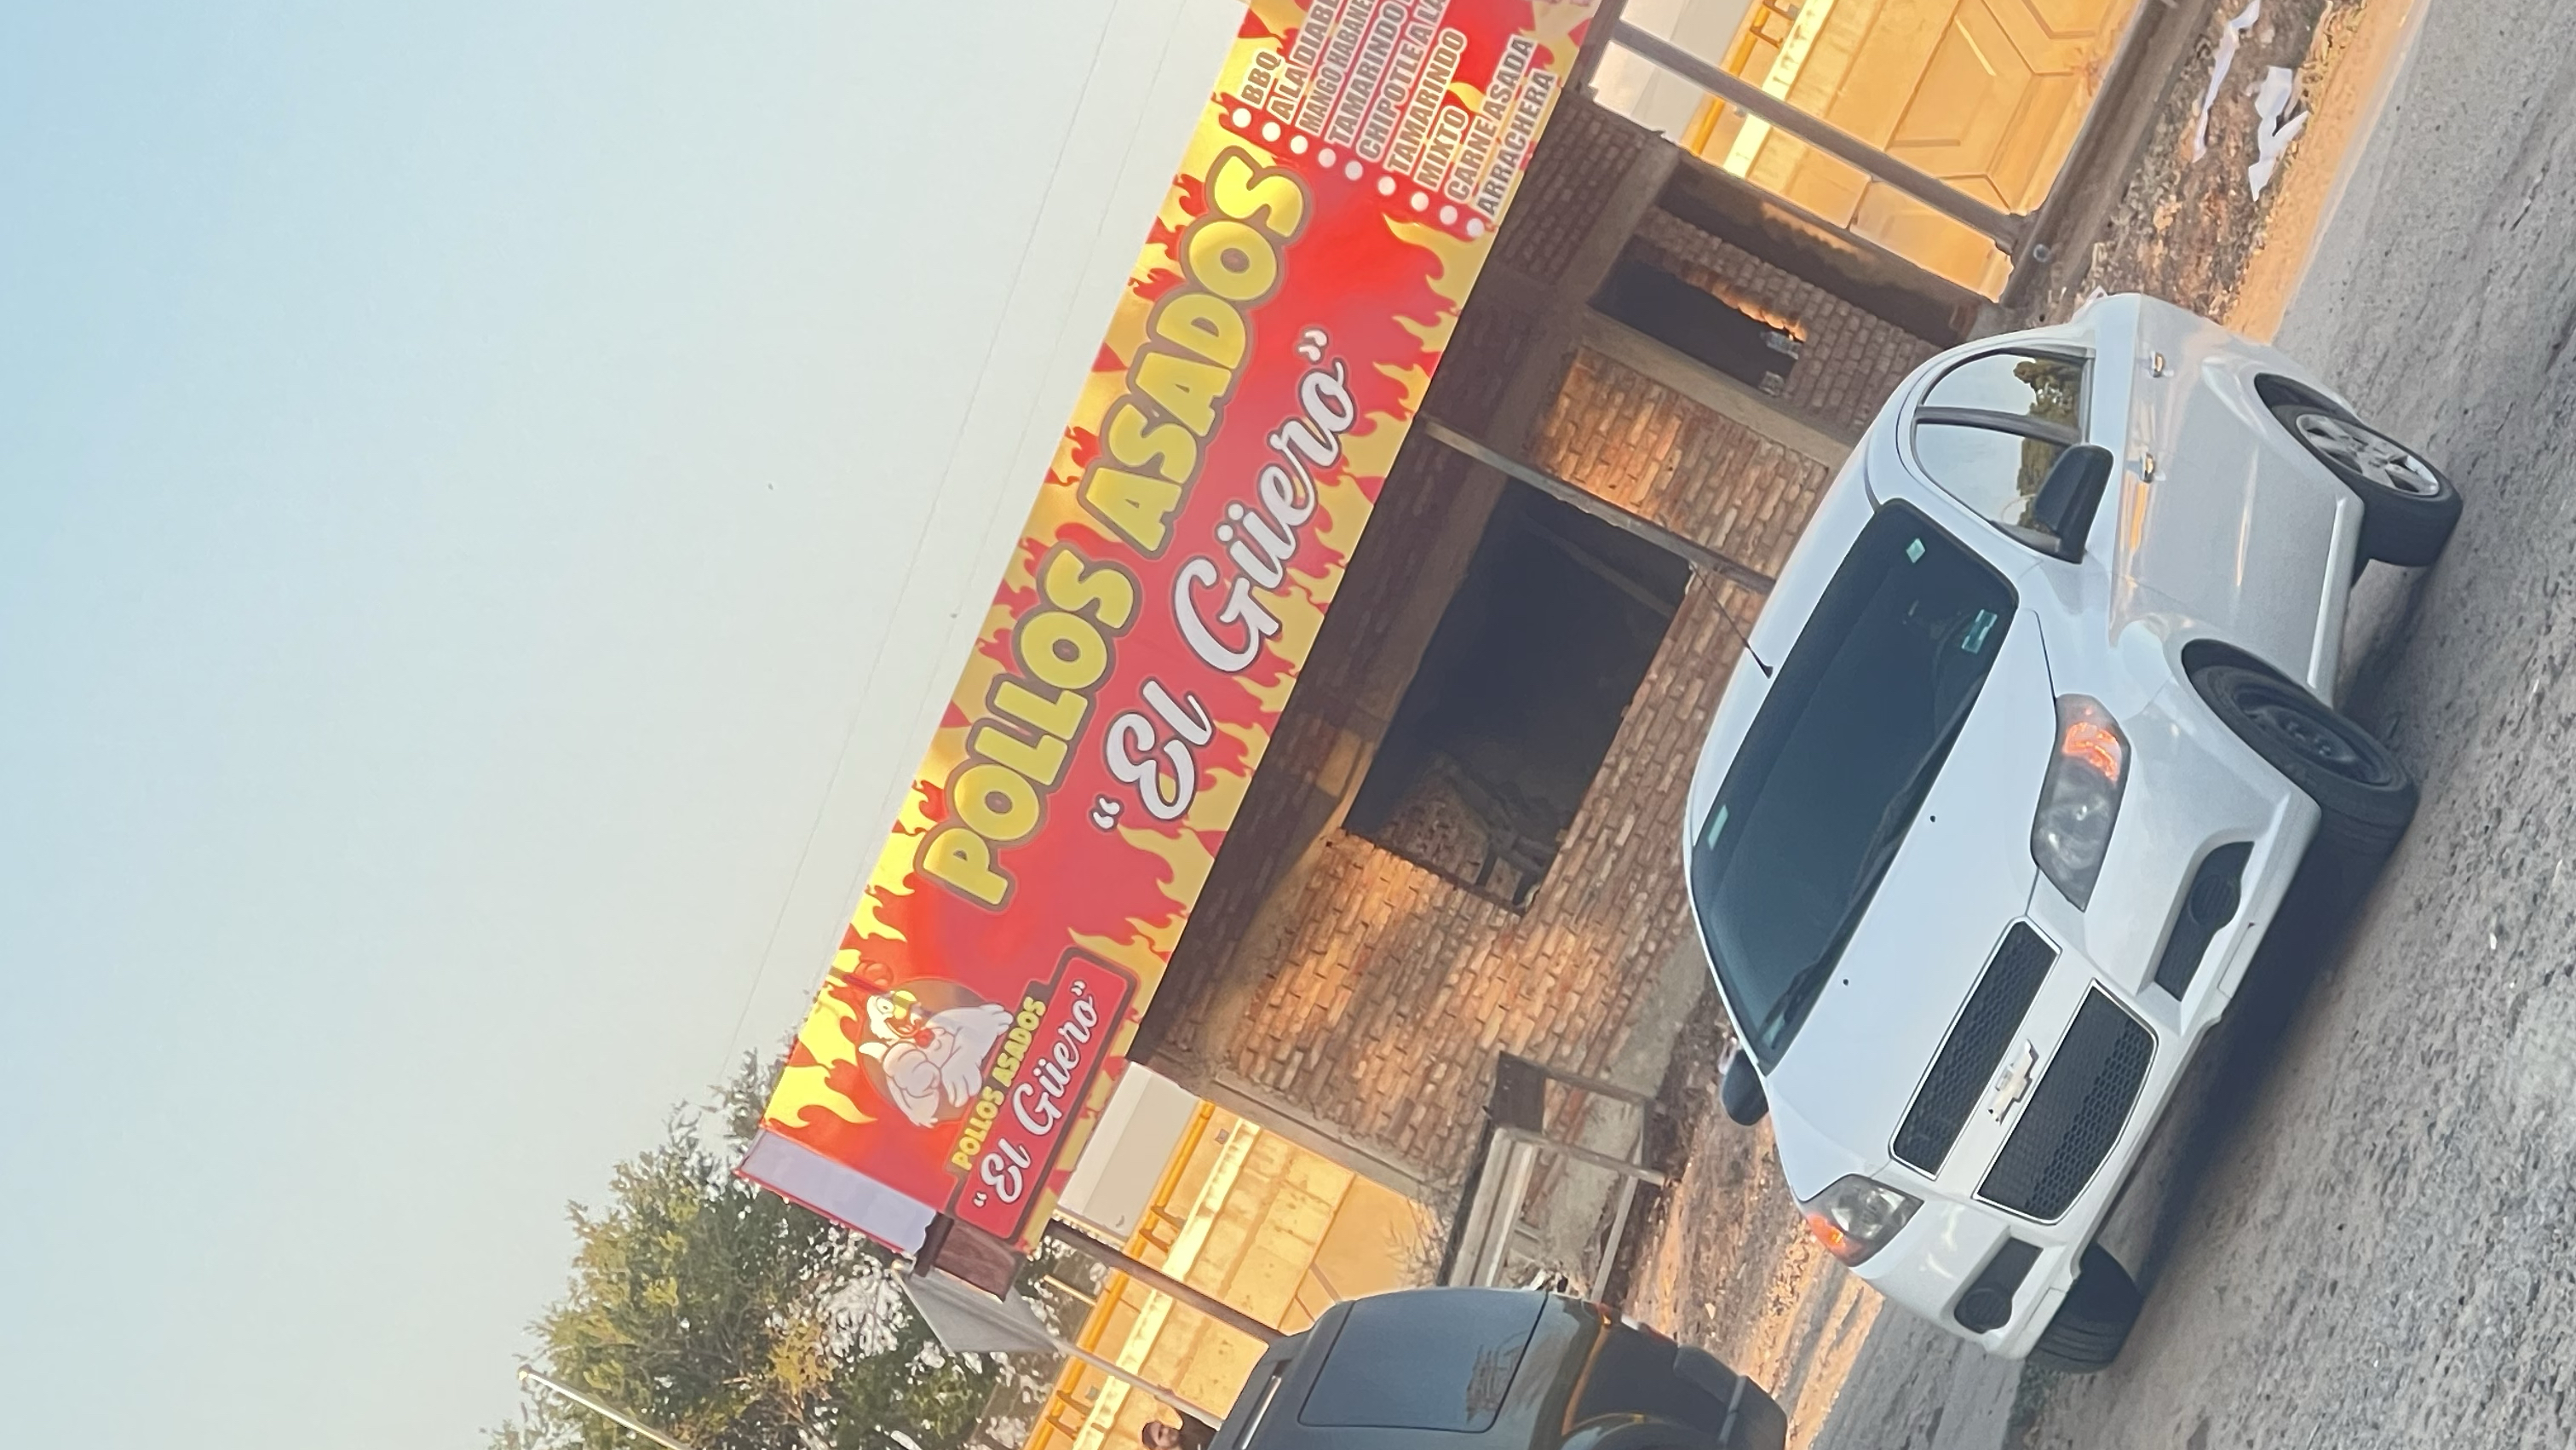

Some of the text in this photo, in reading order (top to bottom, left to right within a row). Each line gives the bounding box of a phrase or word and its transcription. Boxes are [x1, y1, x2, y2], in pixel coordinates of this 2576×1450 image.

[1240, 51, 1281, 105] BBQ
[1270, 100, 1295, 121] A
[1279, 67, 1308, 99] LA
[1298, 0, 1375, 134] MANGO HABANE
[1327, 3, 1405, 144] TAMARINDO
[1358, 43, 1424, 159] CHIPOTLE
[1387, 31, 1464, 173] TAMARINDO
[1446, 37, 1532, 201] CARNE ASADA
[1417, 108, 1466, 188] MIXTO
[1476, 72, 1555, 216] ARRACHERA
[919, 153, 1306, 908] POLLOS ASADOS
[951, 995, 1047, 1171] POLLOS ASADOS
